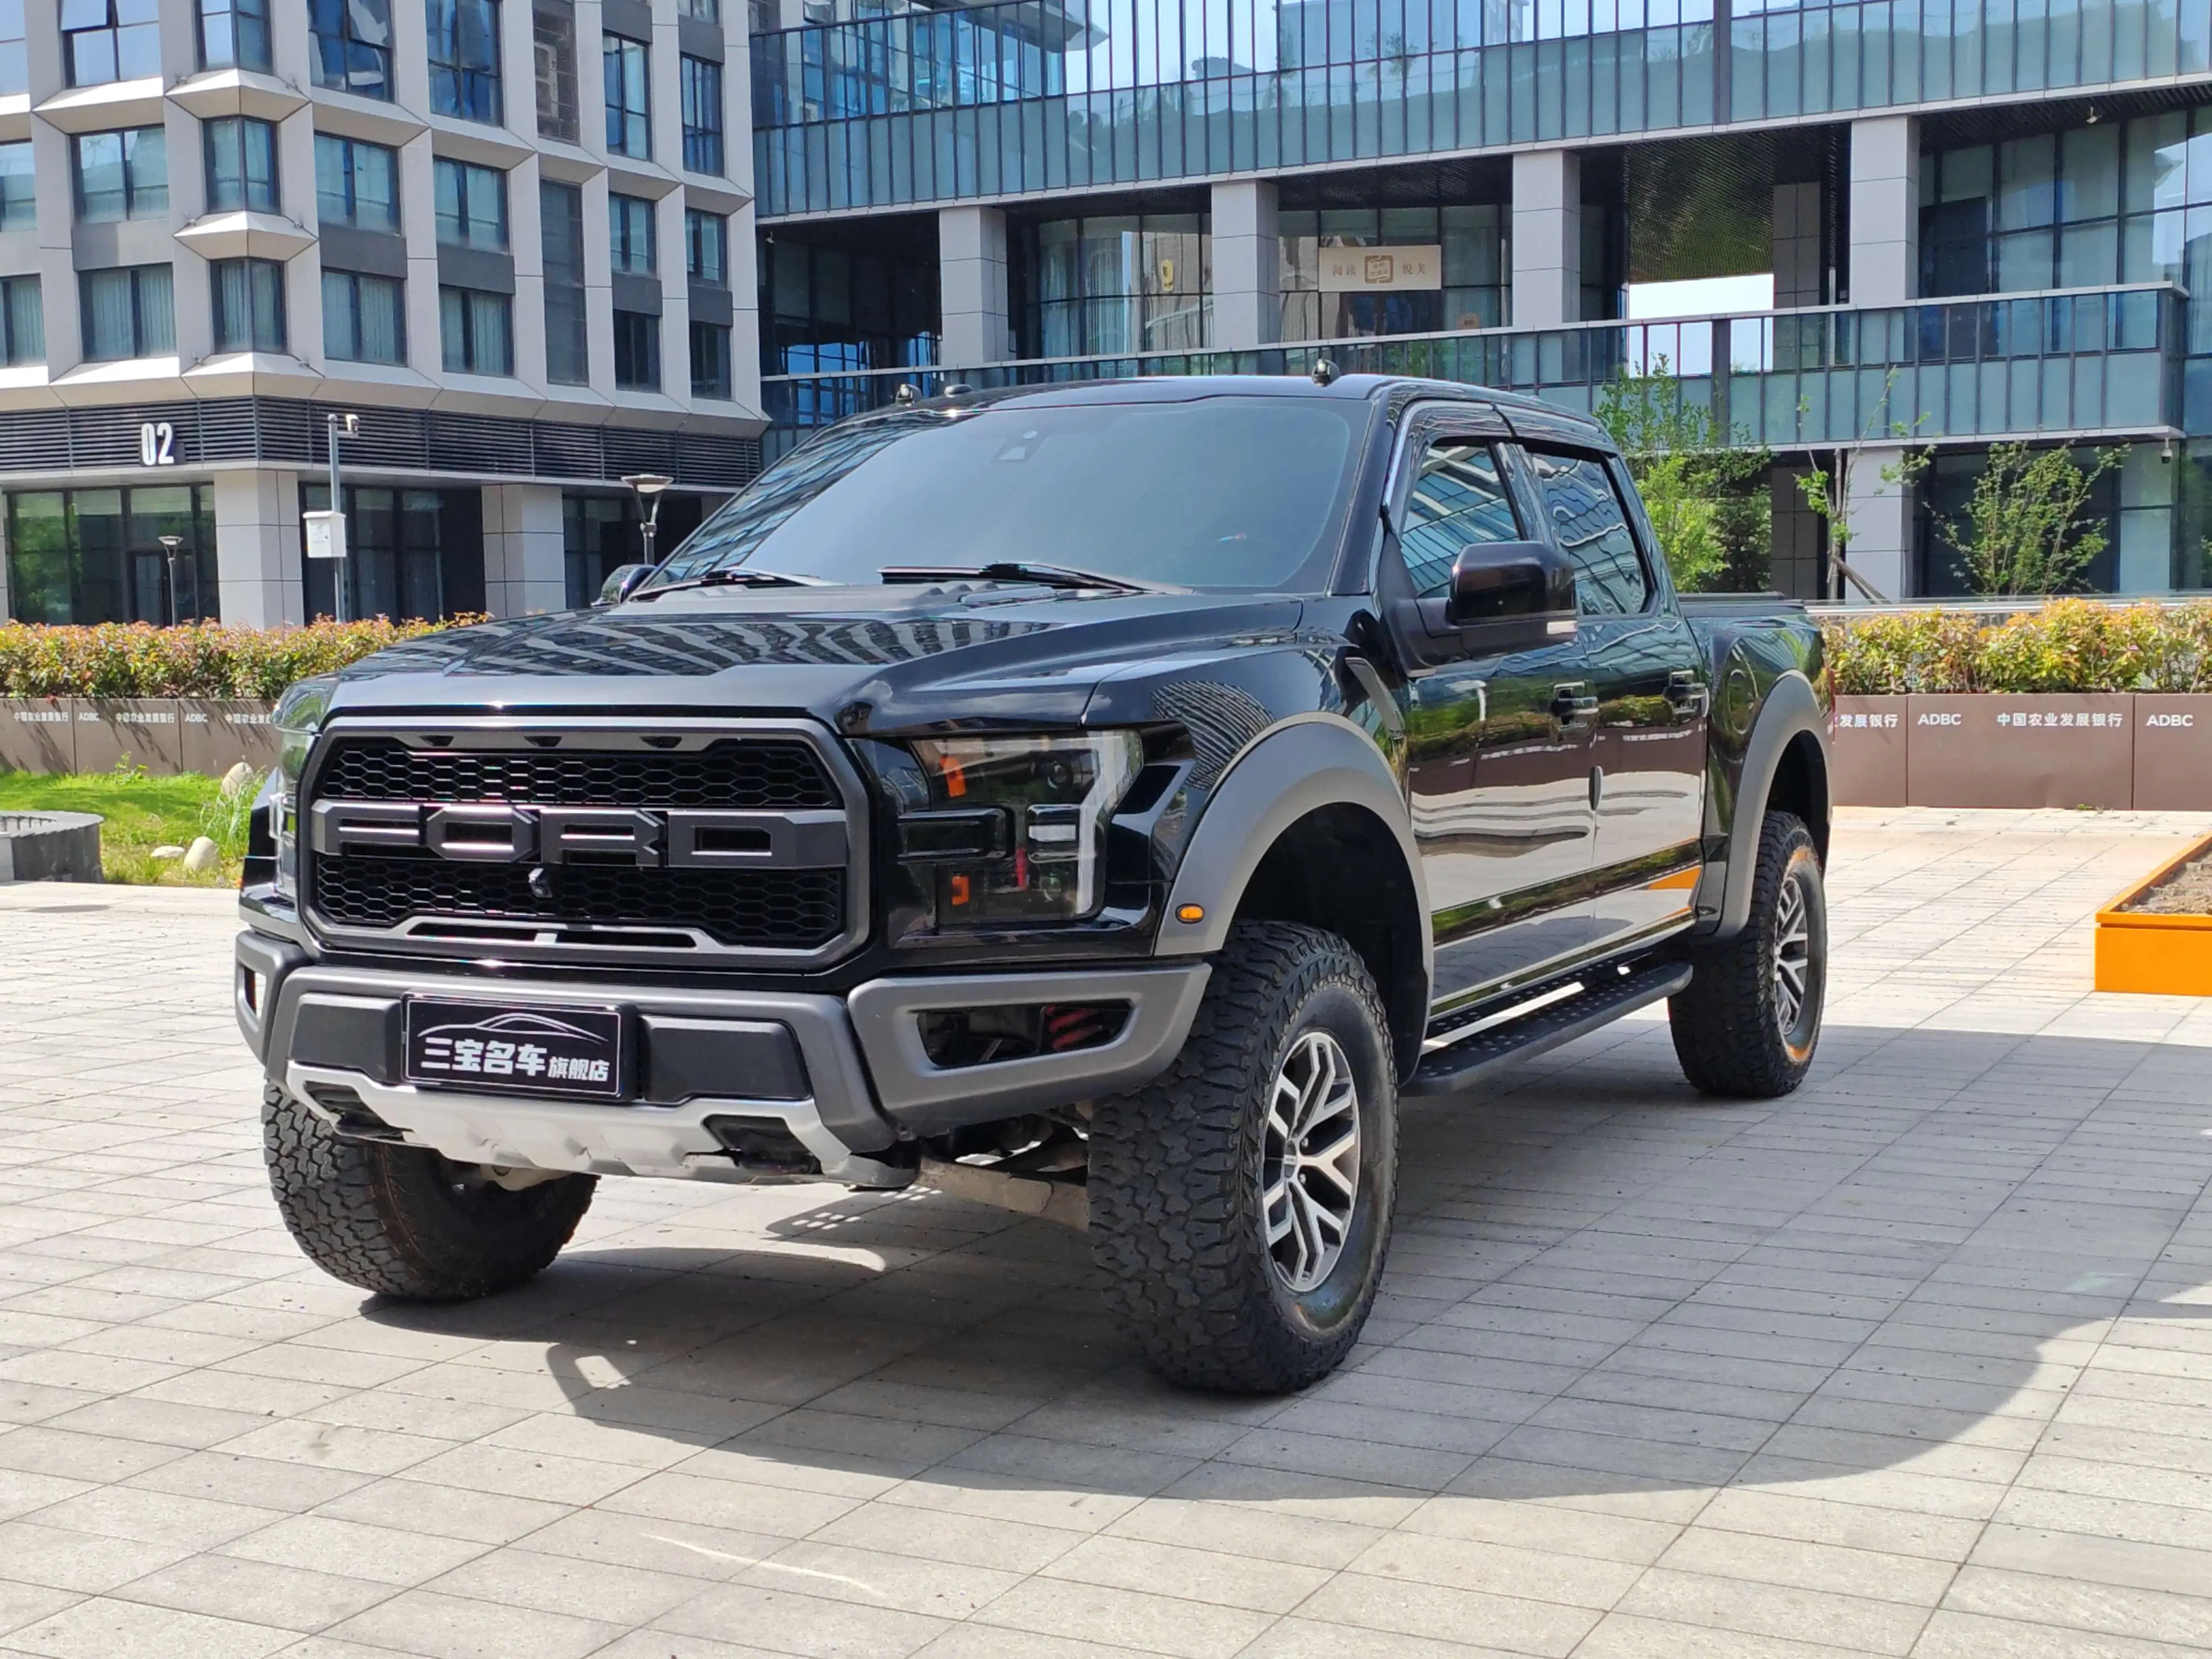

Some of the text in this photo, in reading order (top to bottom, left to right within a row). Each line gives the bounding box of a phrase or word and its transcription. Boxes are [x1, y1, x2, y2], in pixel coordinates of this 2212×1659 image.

[141, 422, 174, 466] 02
[185, 713, 208, 723] ADBC
[1834, 713, 1898, 728] 发展银行
[1918, 713, 1961, 725] ADBC
[1997, 712, 2123, 727] 中国农业发展银行
[2146, 714, 2194, 726] ADBC
[311, 799, 847, 868] FORD
[420, 1037, 610, 1081] 三宝名车 旗舰店
